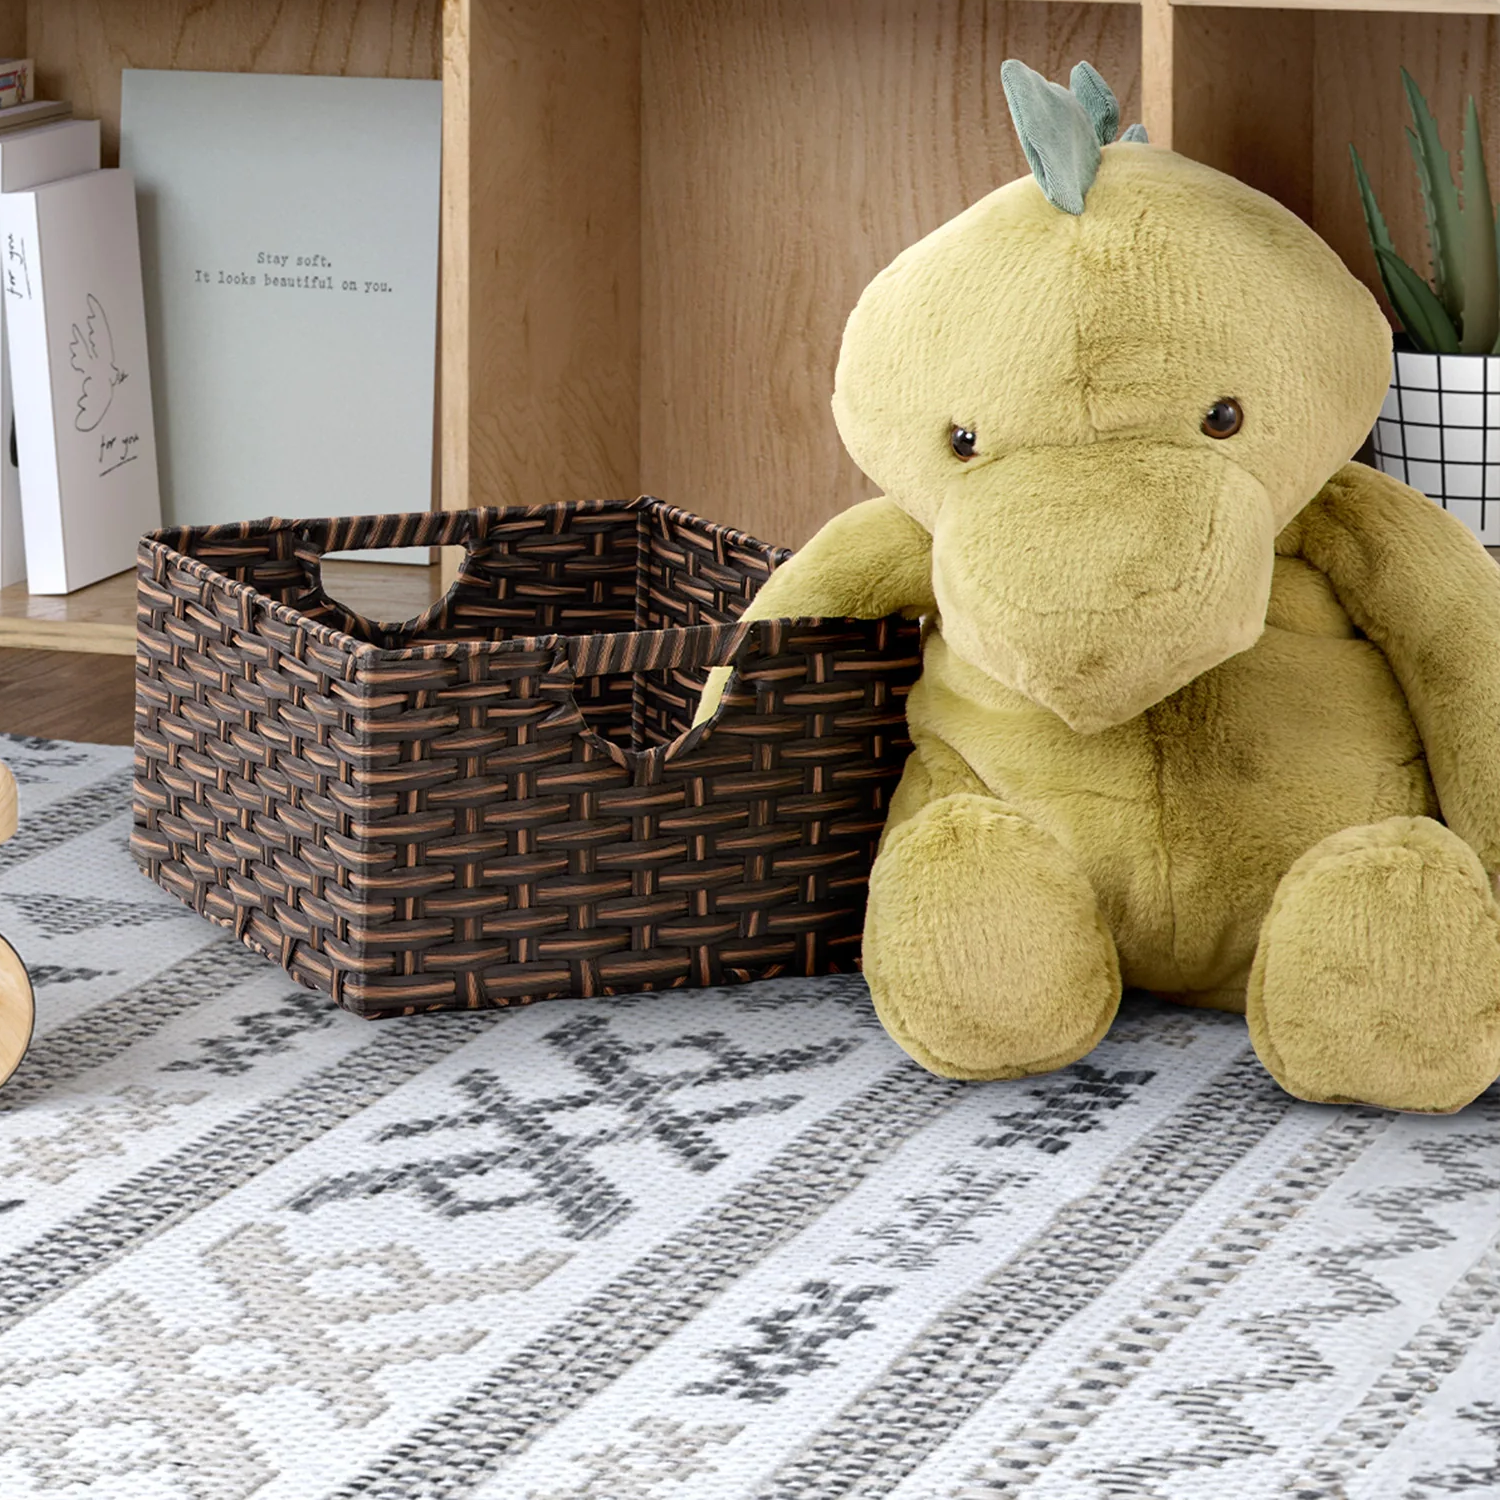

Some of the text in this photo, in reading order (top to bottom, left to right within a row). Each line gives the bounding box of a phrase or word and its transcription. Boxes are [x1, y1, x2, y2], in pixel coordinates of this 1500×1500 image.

[8, 233, 23, 265] you
[256, 251, 332, 268] Stay soft.
[194, 270, 393, 293] It looks beautiful on you.
[119, 433, 140, 461] you
